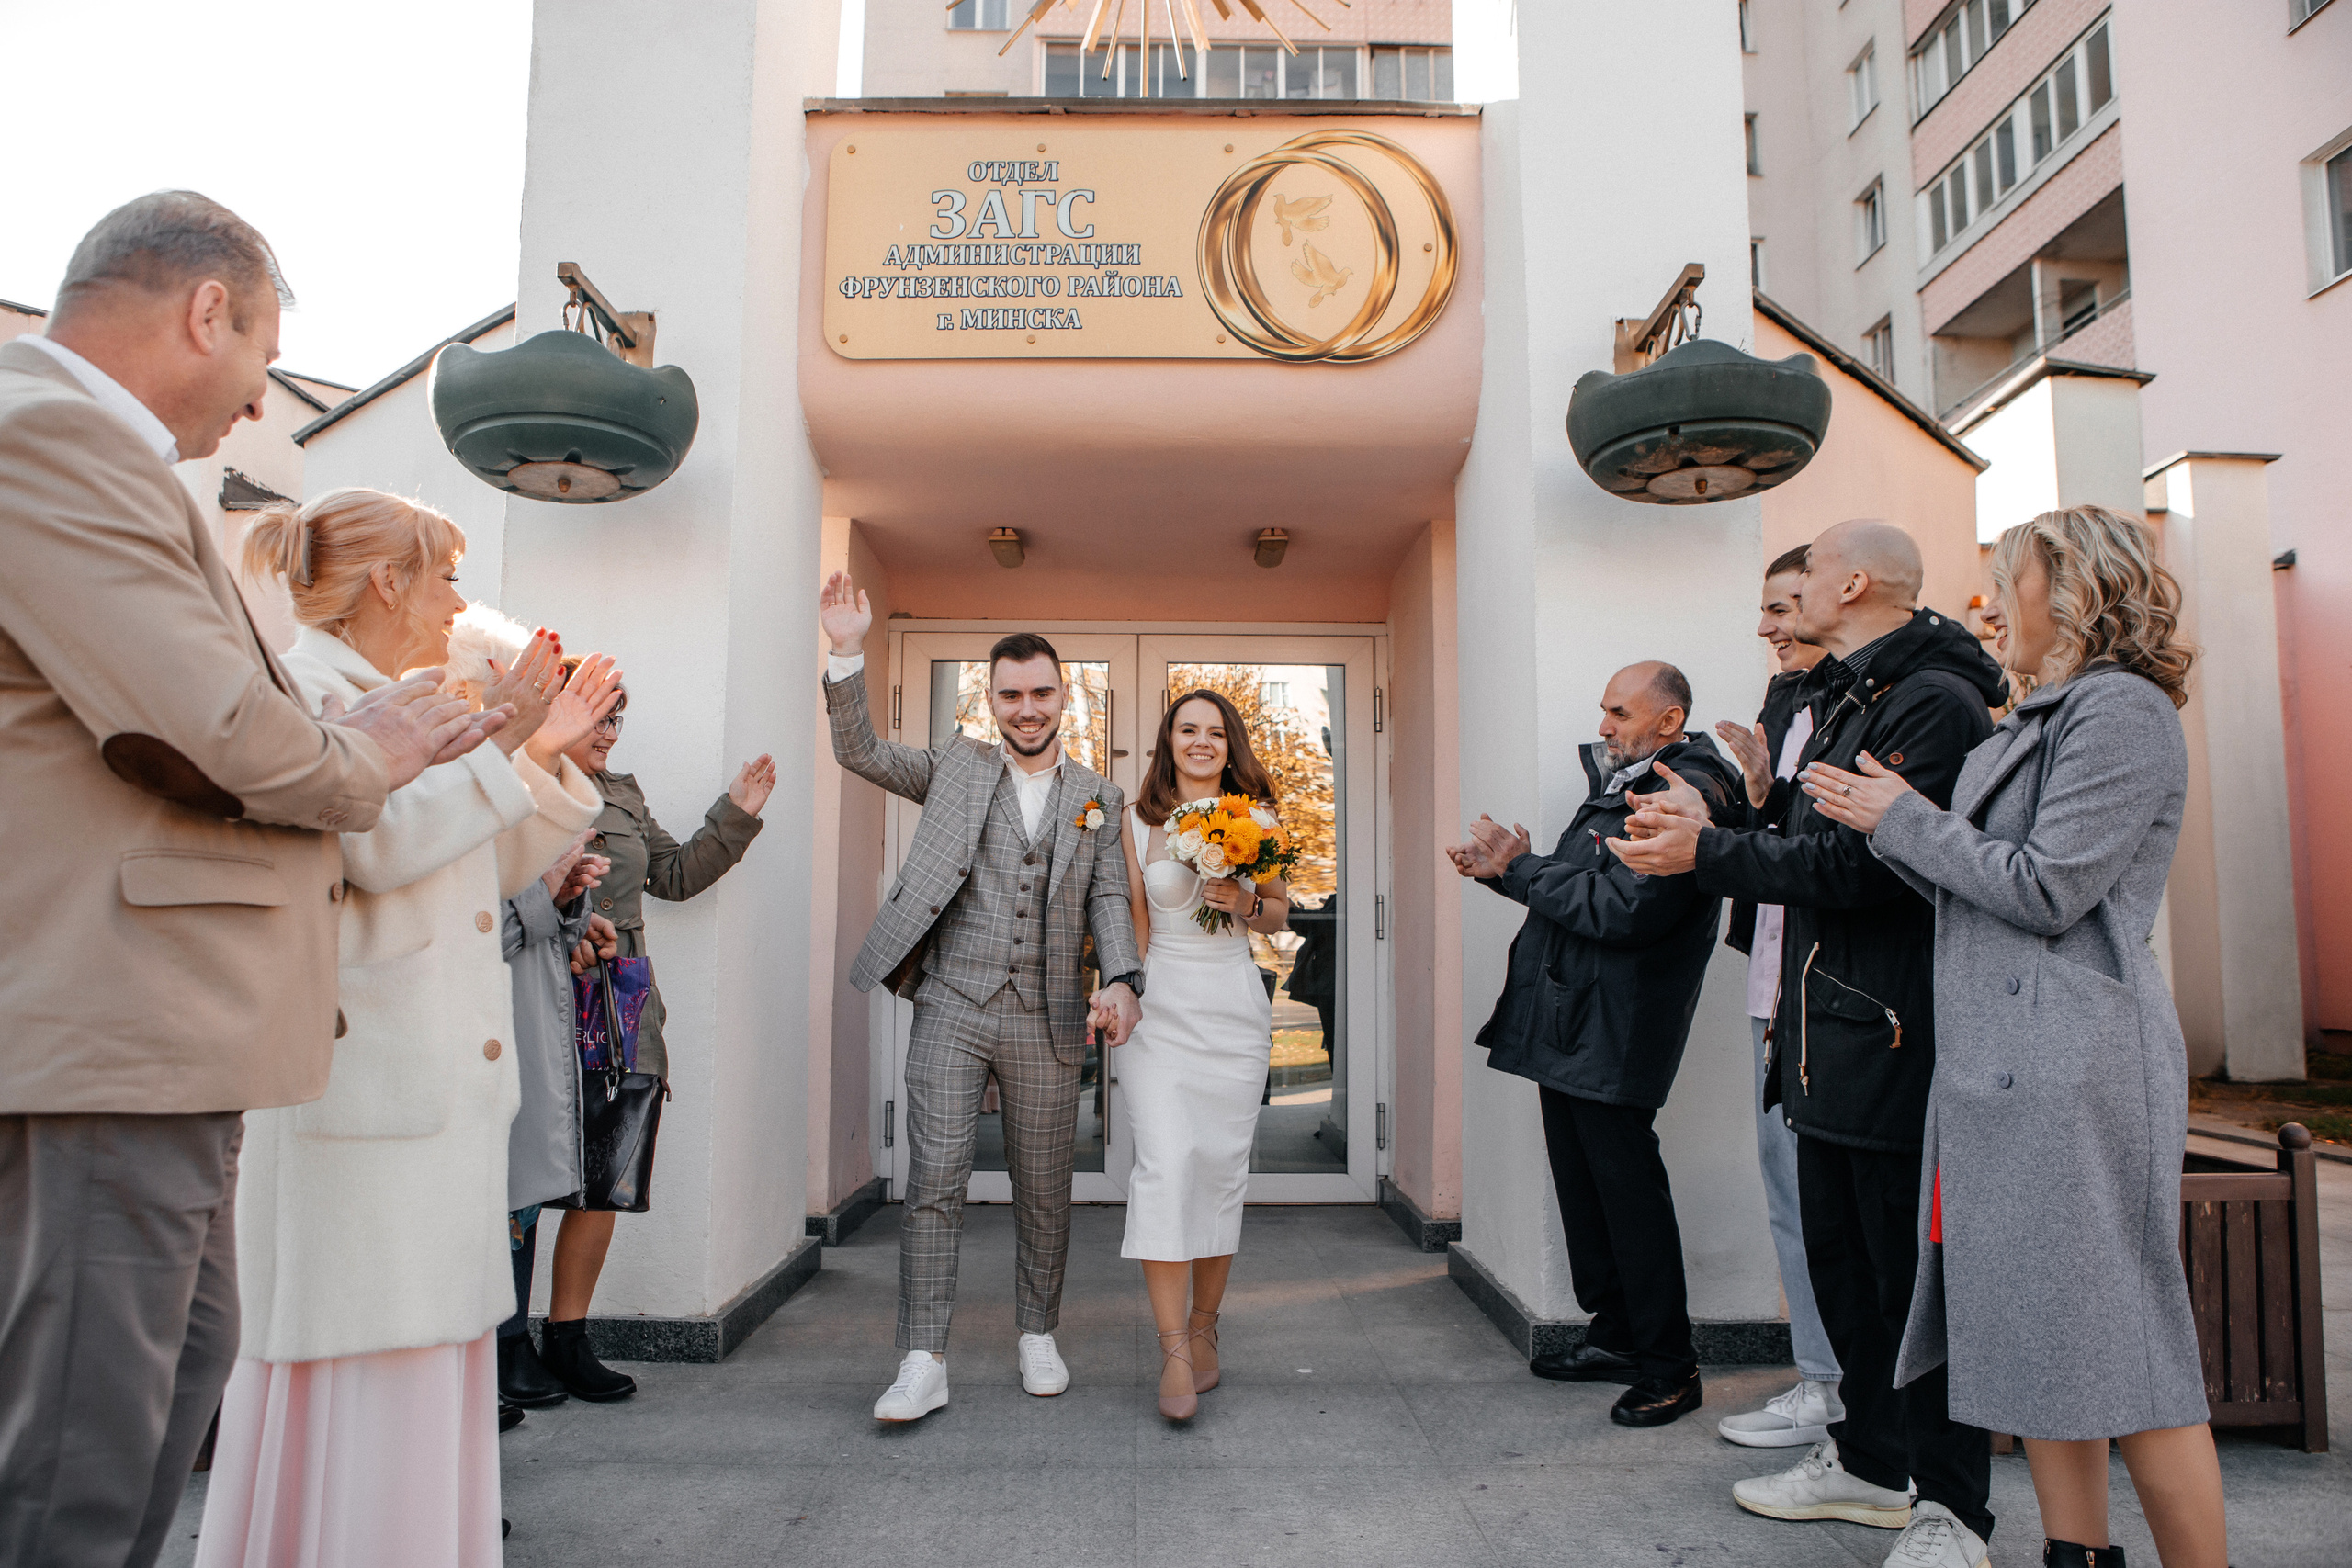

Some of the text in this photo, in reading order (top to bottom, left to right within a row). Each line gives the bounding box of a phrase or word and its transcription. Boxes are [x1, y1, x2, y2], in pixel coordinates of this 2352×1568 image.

[967, 161, 1059, 186] ОТДЕЛ
[930, 189, 1095, 239] ЗАГС
[883, 244, 1141, 270] АДМИНИСТРАЦИИ
[839, 270, 1183, 299] ФРУНЗЕНСКОГО РАЙОНА
[937, 308, 1082, 330] г. МИНСКА
